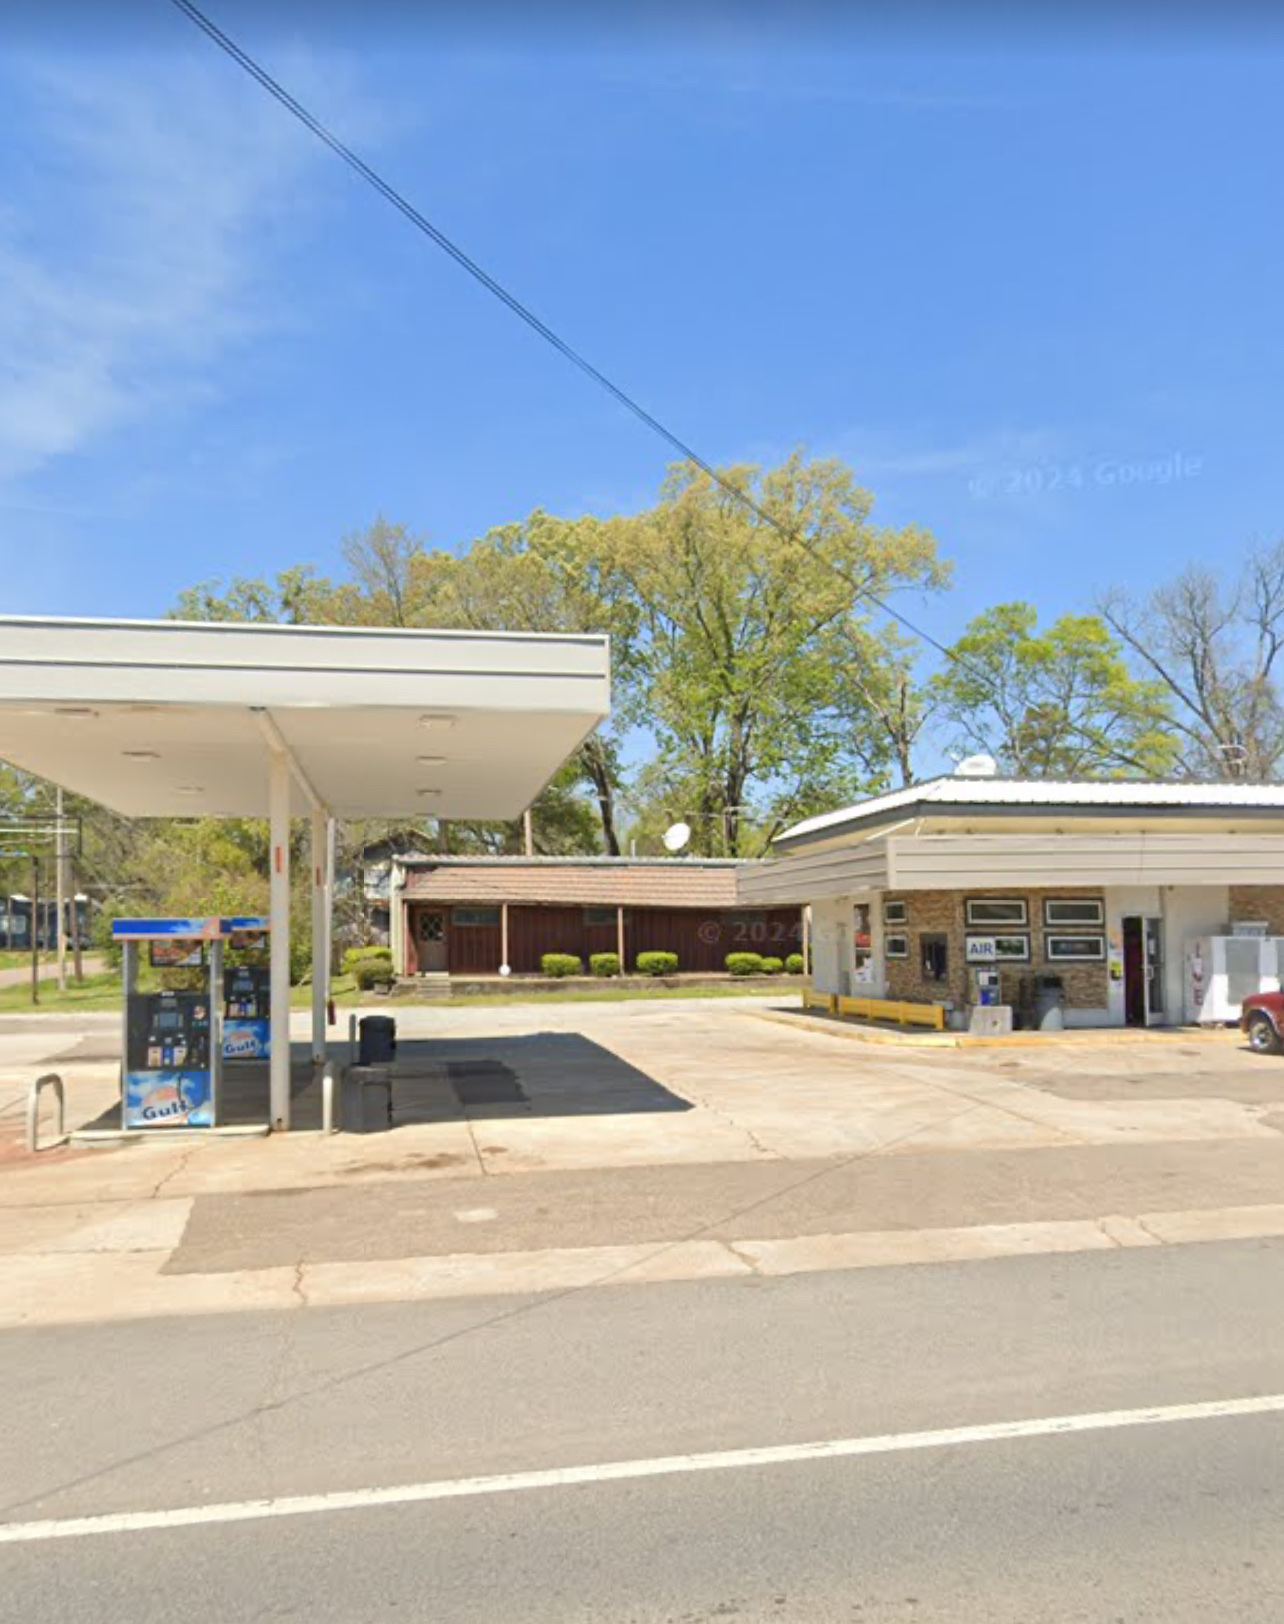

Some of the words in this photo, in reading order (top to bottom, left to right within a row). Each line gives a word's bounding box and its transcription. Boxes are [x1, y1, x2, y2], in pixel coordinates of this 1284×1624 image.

[970, 941, 994, 955] AIR
[225, 1039, 256, 1054] Gulf
[143, 1100, 188, 1119] Gulf
